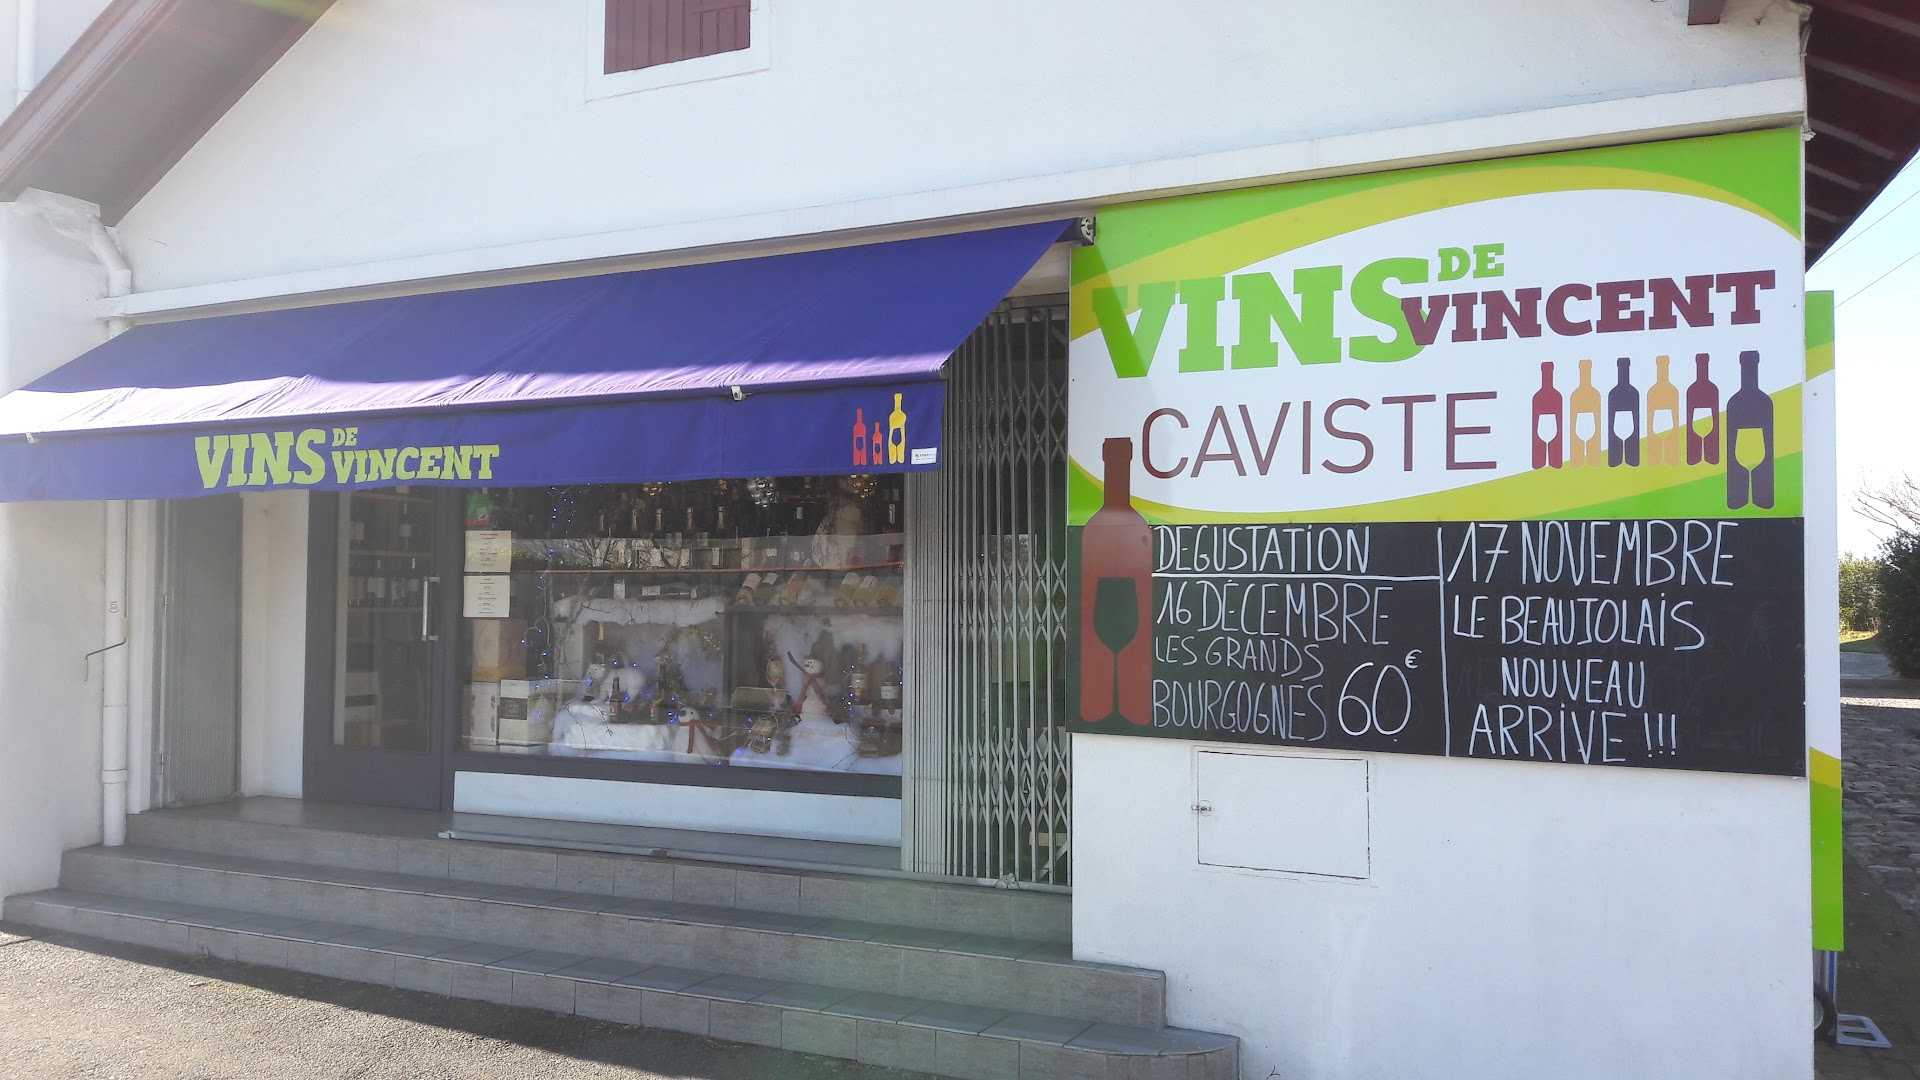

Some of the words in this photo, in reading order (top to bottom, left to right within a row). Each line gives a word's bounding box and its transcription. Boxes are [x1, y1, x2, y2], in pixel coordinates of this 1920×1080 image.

[1438, 242, 1505, 282] DE
[1092, 257, 1429, 379] VINS
[1401, 269, 1776, 346] VINCENT
[194, 427, 327, 490] VINS
[330, 444, 500, 485] VINCENT
[331, 426, 359, 448] DE
[1141, 390, 1498, 479] CAVISTE
[1446, 521, 1510, 584] 17
[1521, 520, 1739, 586] NOVEMBRE
[1156, 581, 1192, 625] 16
[1453, 594, 1489, 638] LE
[1501, 592, 1706, 651] BEAUJOLAIS
[1155, 635, 1199, 666] LES
[1204, 636, 1325, 682] GRANDS
[1501, 656, 1646, 709] NOUVEAU
[1152, 679, 1328, 742] BOURGOGNES
[1468, 702, 1627, 765] ARRIVE
